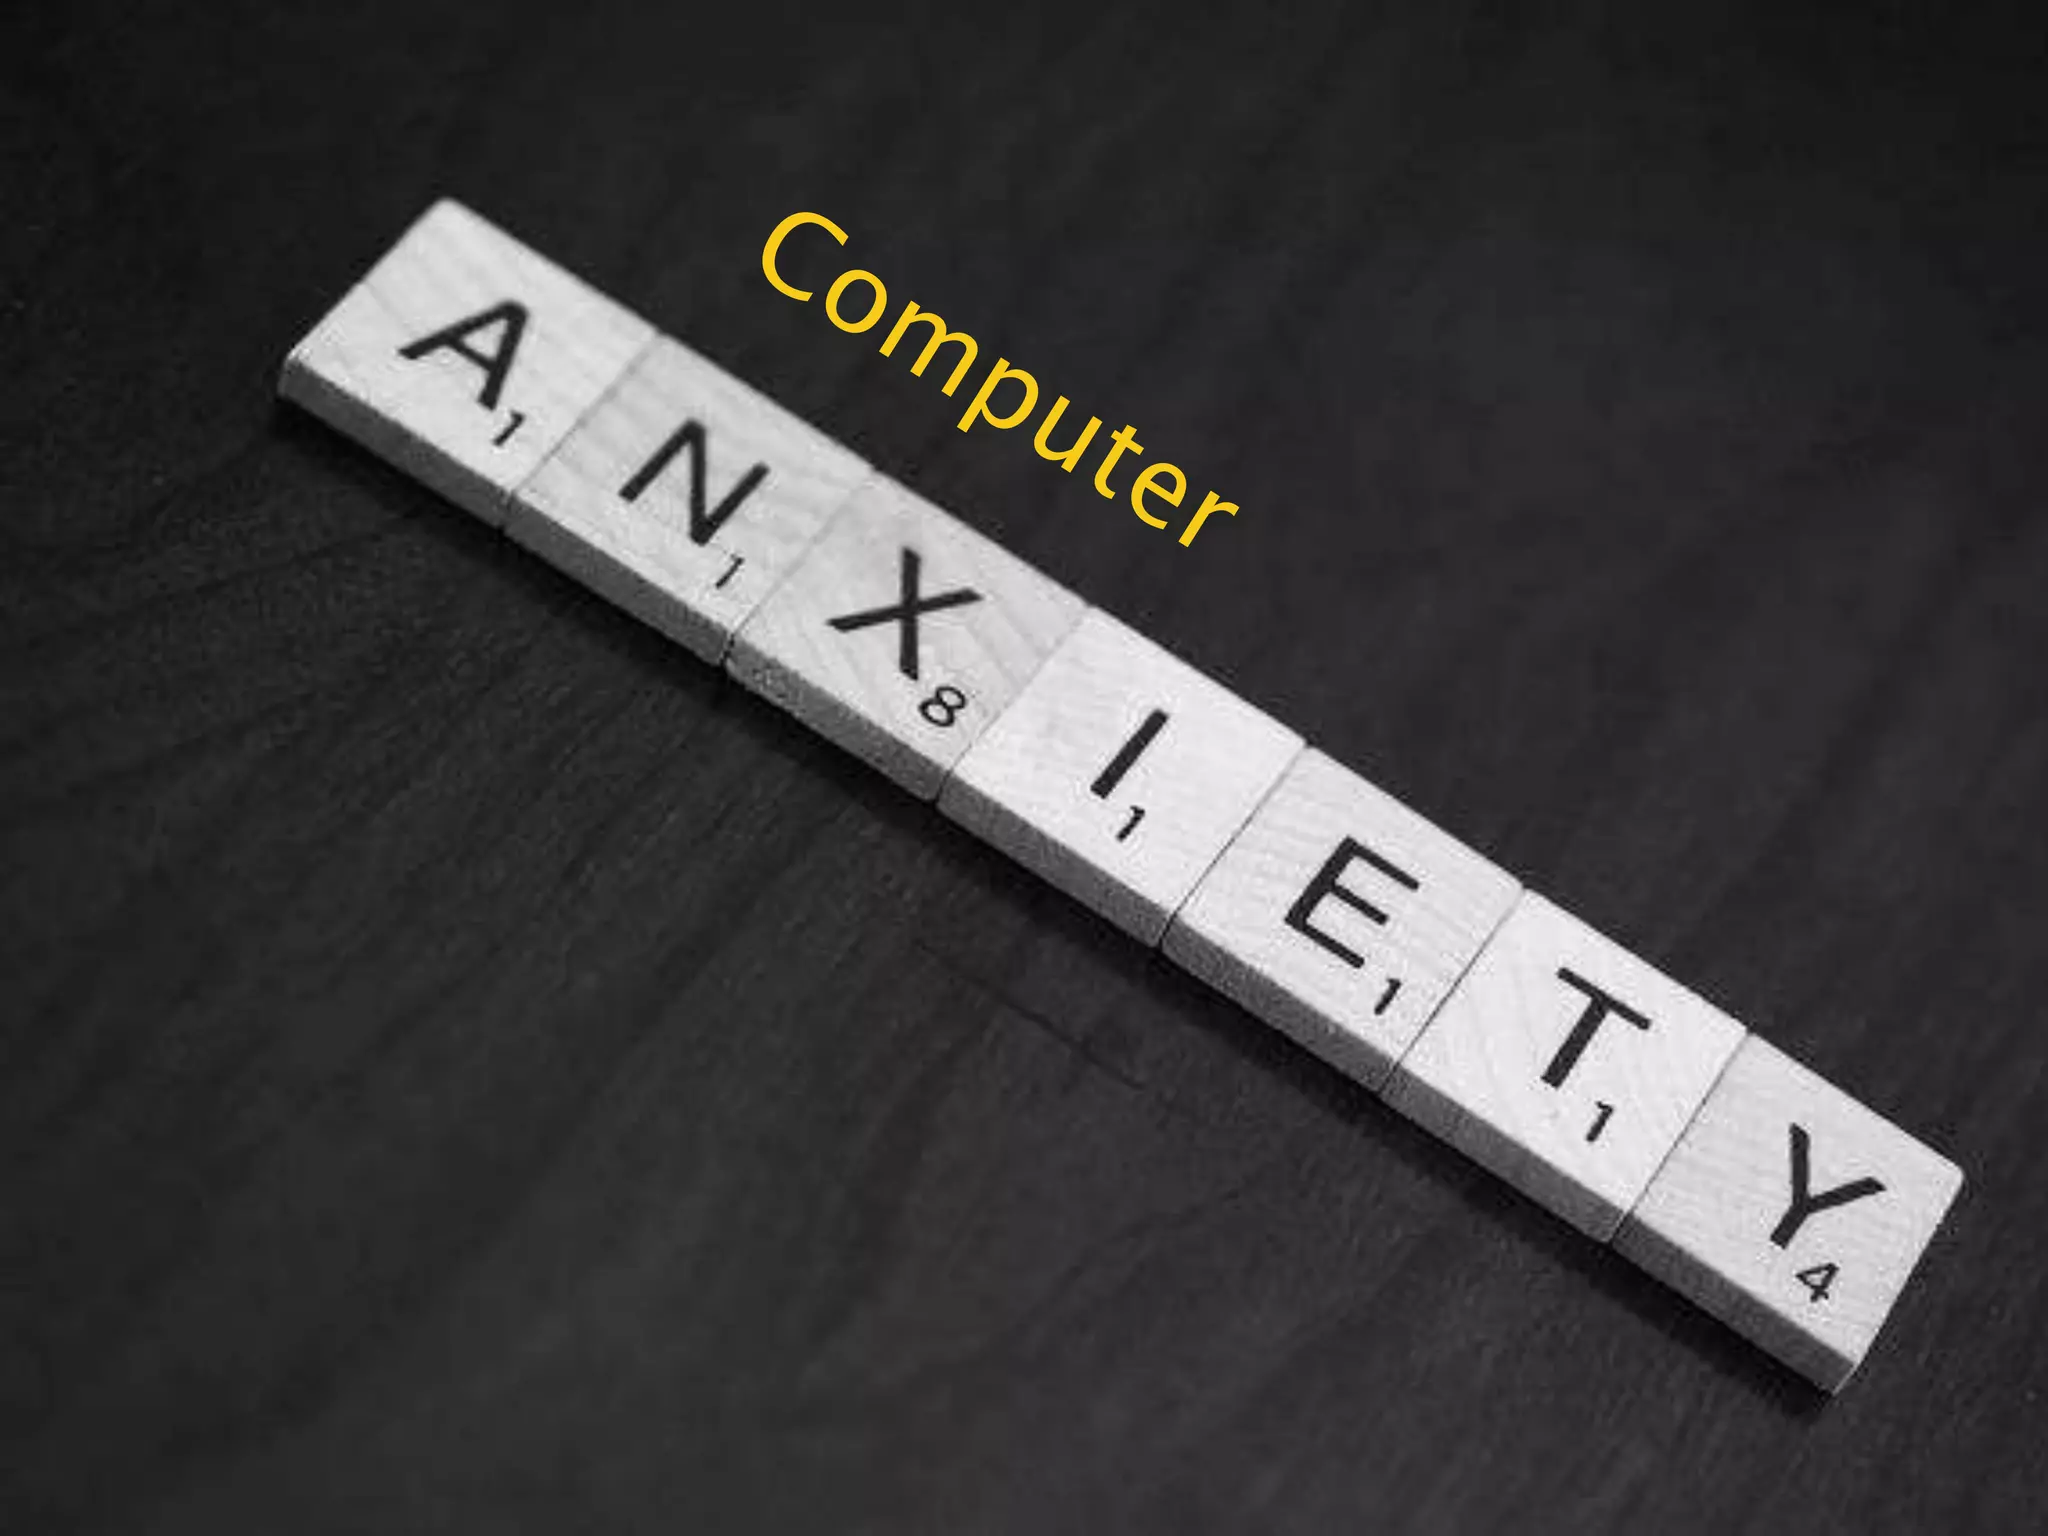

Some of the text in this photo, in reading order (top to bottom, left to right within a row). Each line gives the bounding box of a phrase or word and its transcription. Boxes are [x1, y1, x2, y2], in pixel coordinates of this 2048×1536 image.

[917, 685, 967, 729] 8
[1116, 805, 1146, 842] 1
[1372, 977, 1403, 1017] 1
[1584, 1100, 1614, 1143] 1
[1794, 1261, 1841, 1304] 4
